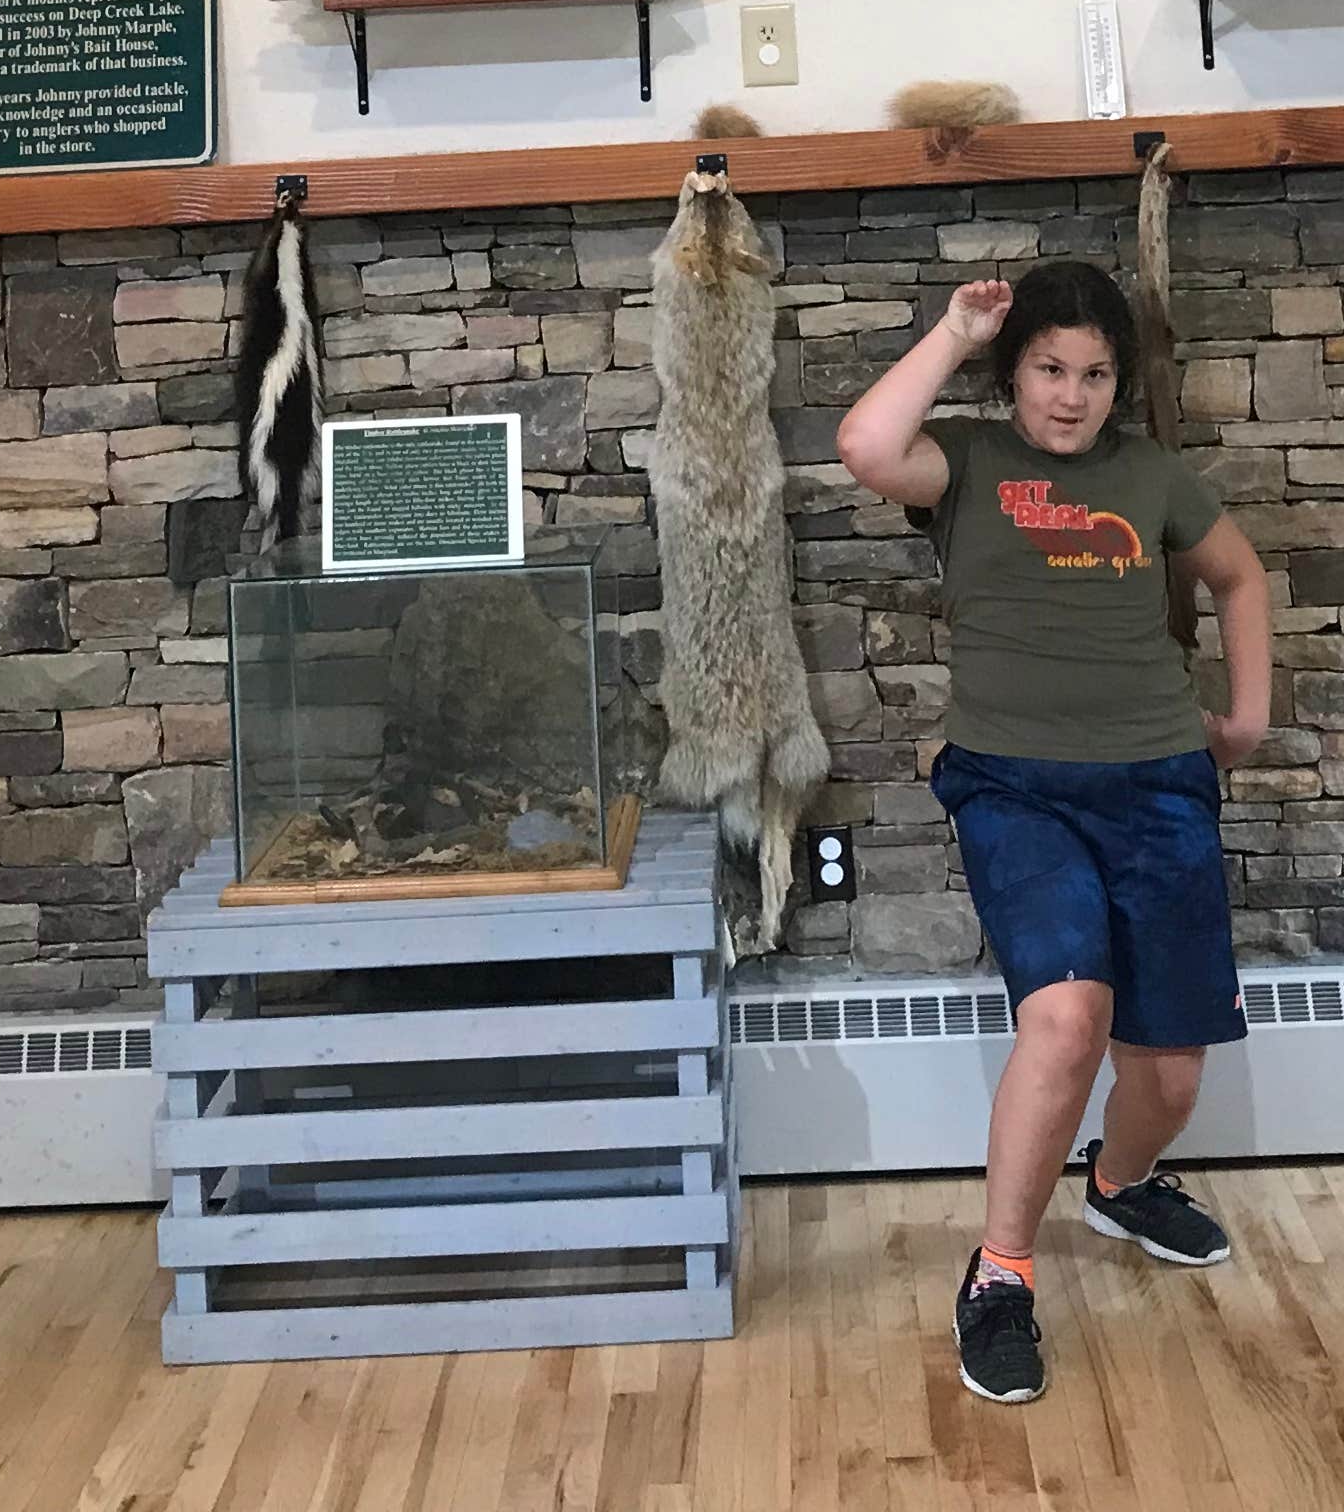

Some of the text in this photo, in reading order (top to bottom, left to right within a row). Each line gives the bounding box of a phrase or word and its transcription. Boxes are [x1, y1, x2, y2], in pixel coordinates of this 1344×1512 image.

[0, 10, 46, 24] success
[49, 10, 64, 21] on
[69, 7, 102, 23] Deep
[105, 5, 143, 19] Creek
[7, 28, 21, 40] in
[24, 26, 54, 39] 2003
[57, 25, 72, 40] by
[74, 23, 123, 39] Johnny
[125, 20, 177, 36] Marple,
[8, 45, 22, 58] of
[23, 41, 80, 59] Johnny's
[84, 40, 110, 54] Bait
[0, 64, 8, 75] a
[11, 60, 81, 75] trademark
[85, 58, 100, 72] of
[101, 57, 126, 70] that
[130, 54, 187, 69] business.
[35, 89, 83, 105] Johnny
[85, 84, 141, 101] provided
[145, 82, 189, 98] tackle,
[68, 105, 93, 118] and
[97, 105, 113, 117] an
[116, 100, 183, 115] occasional
[16, 125, 29, 138] to
[32, 122, 81, 140] anglers
[84, 121, 110, 134] who
[113, 117, 166, 134] shopped
[19, 139, 96, 155] in the store.
